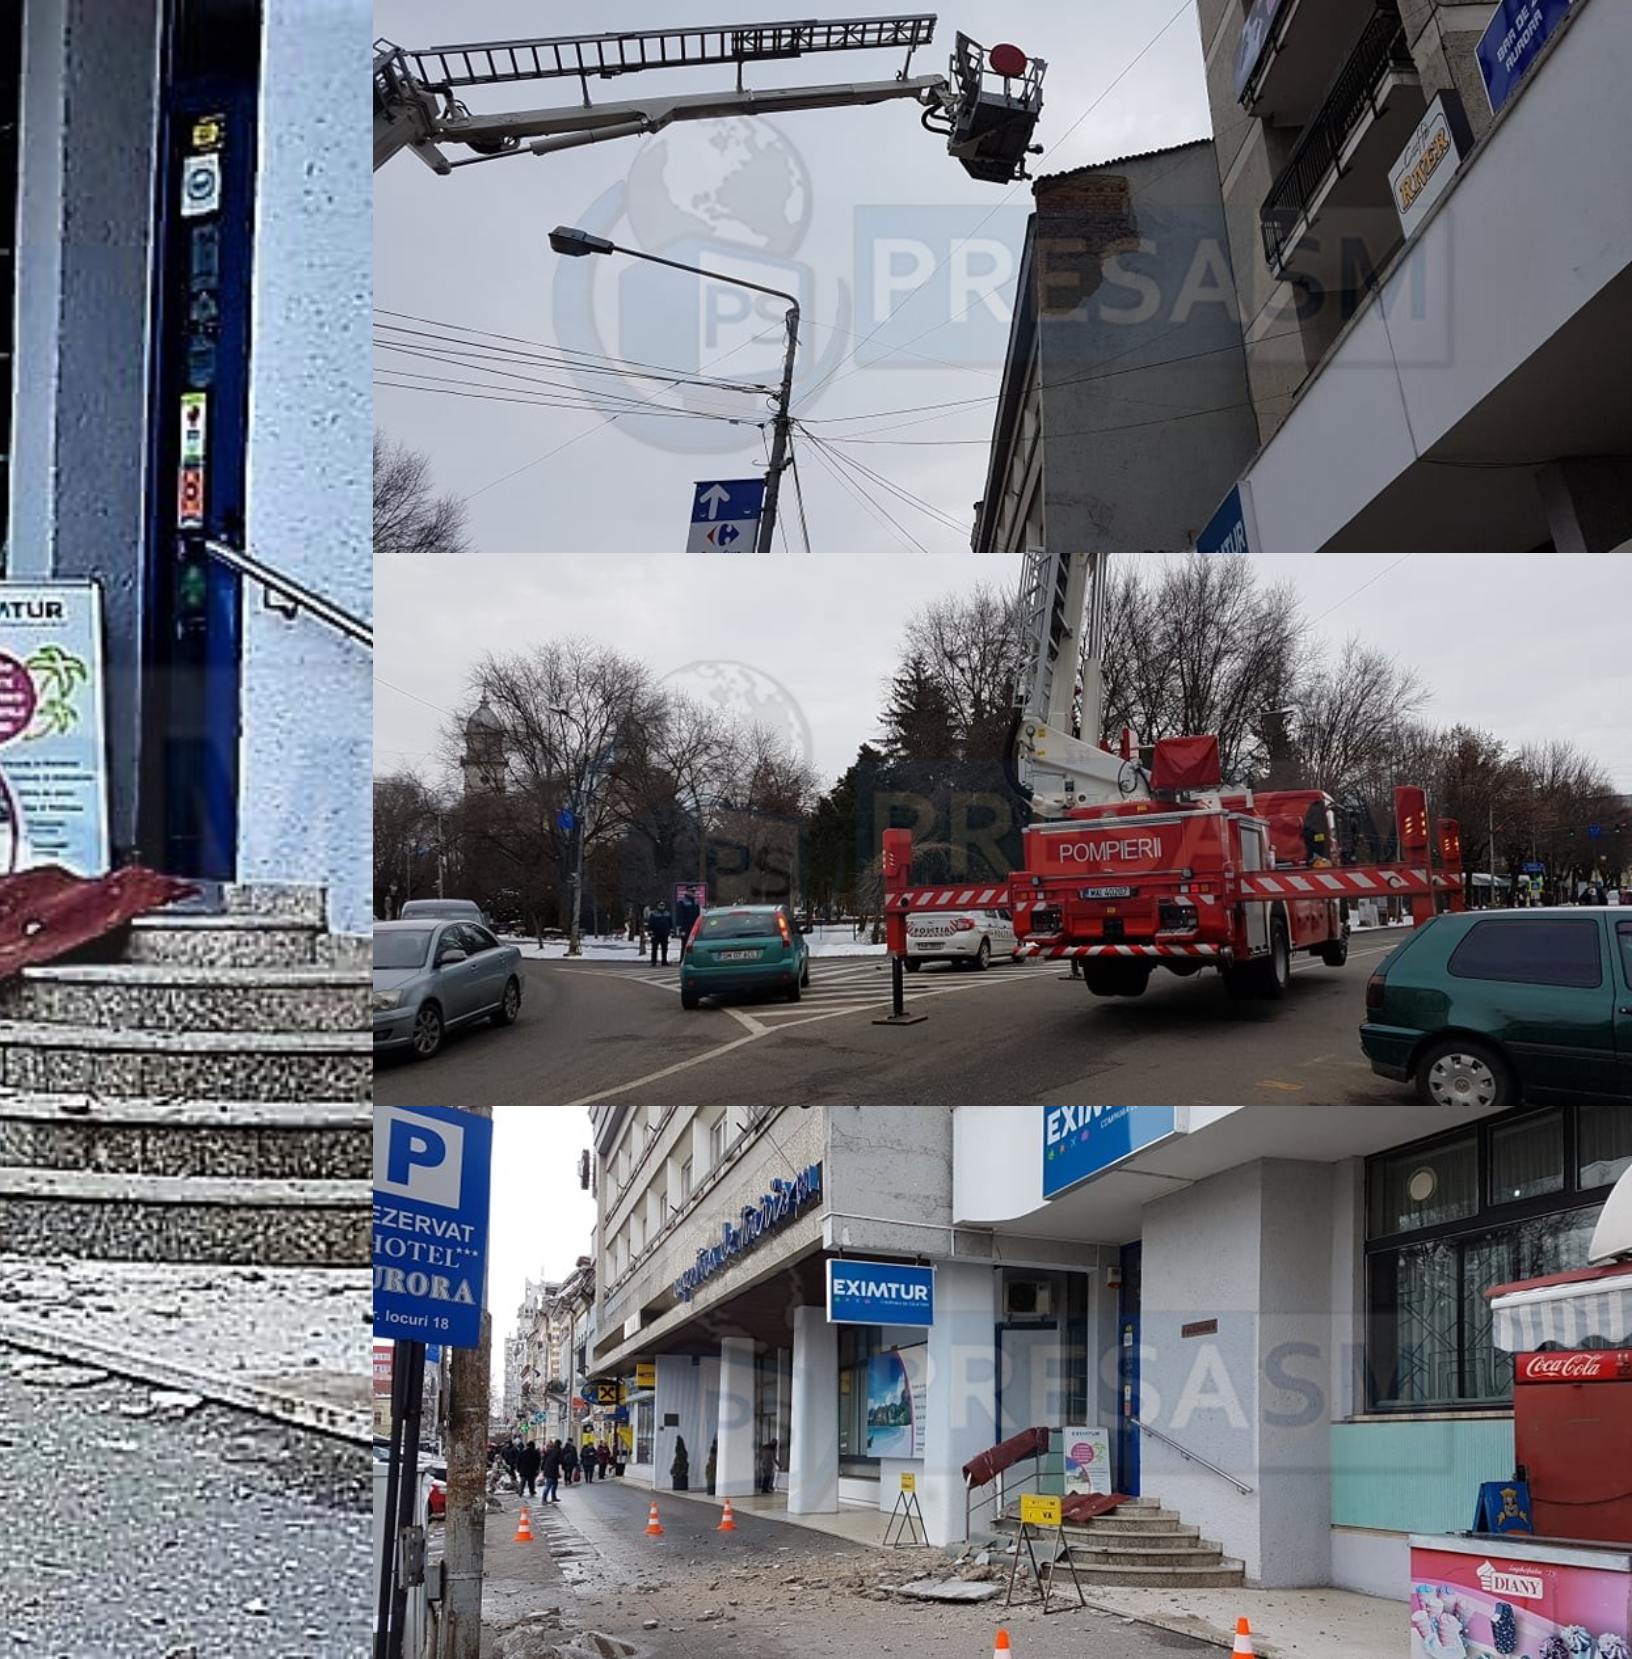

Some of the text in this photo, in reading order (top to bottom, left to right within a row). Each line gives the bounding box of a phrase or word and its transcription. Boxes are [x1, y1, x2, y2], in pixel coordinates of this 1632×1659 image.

[1506, 9, 1543, 72] AURORA
[1216, 520, 1246, 553] TUR
[1059, 837, 1162, 863] POMPIERII
[387, 1118, 446, 1186] P
[833, 1279, 928, 1300] EXIMTUR
[385, 1310, 428, 1328] locuri
[433, 1317, 449, 1330] 18
[1494, 1576, 1539, 1595] DIANY
